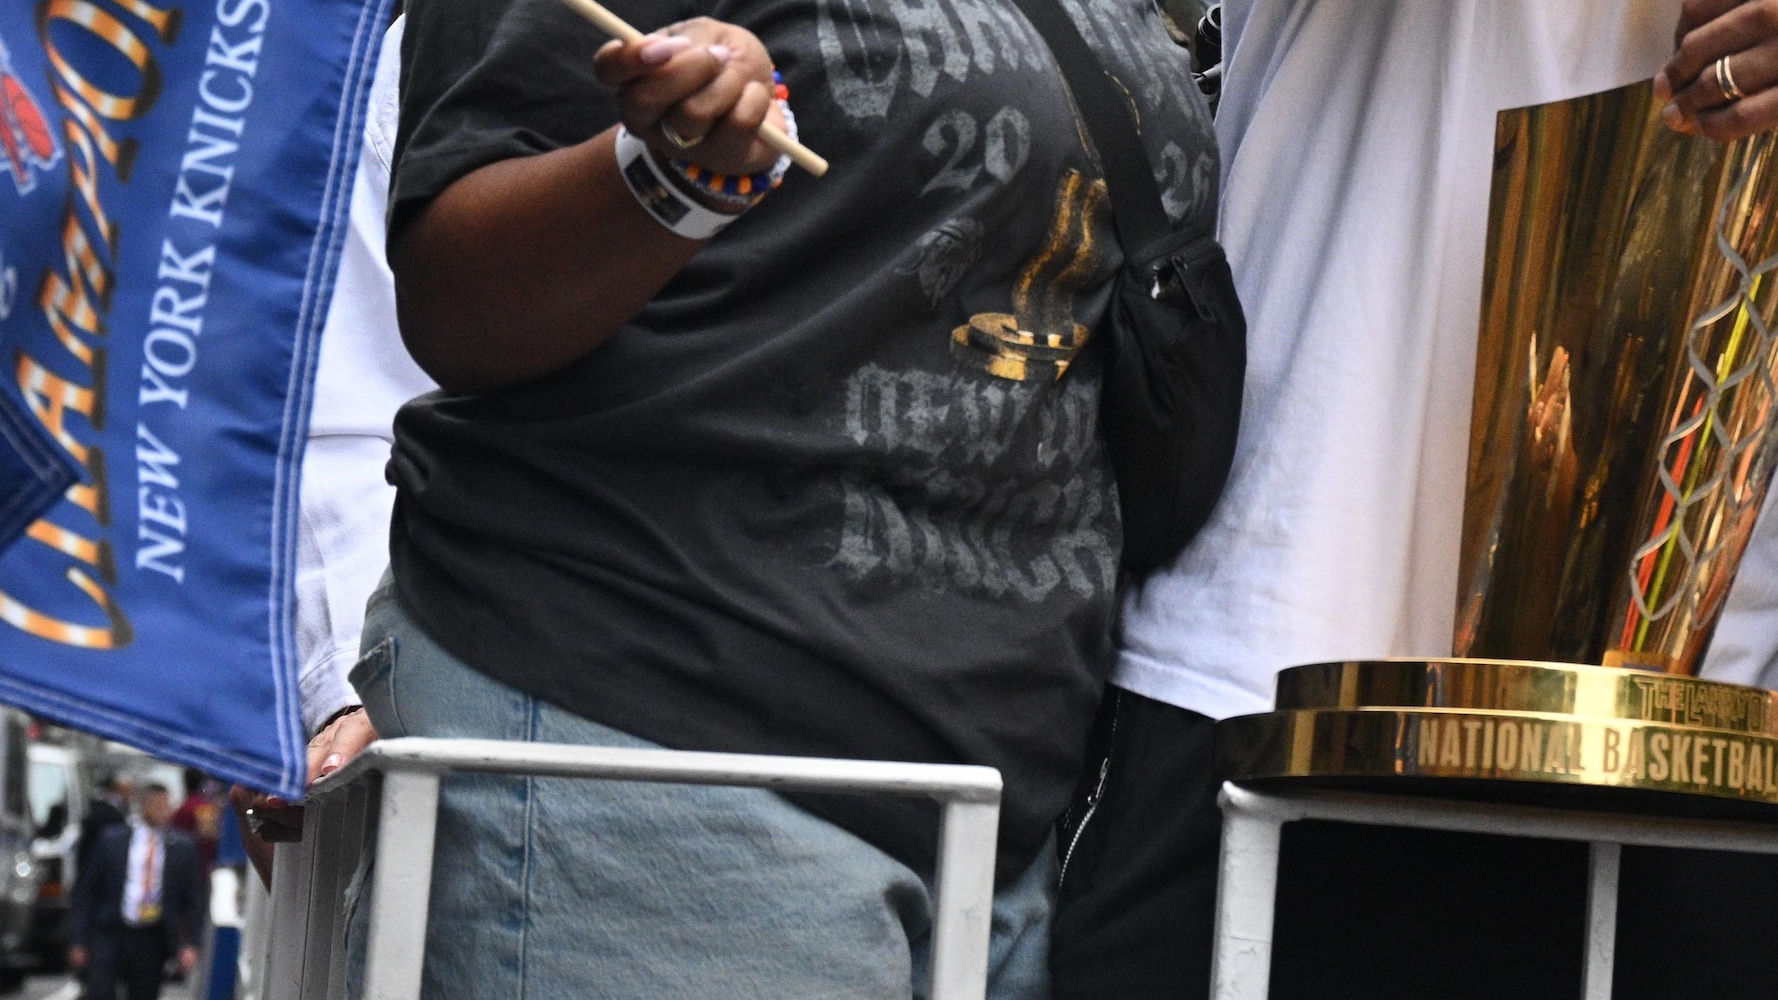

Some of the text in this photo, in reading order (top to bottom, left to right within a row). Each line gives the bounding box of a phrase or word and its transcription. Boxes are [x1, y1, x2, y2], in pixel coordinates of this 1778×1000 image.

[920, 105, 1031, 197] 20
[138, 236, 218, 411] YORK
[136, 424, 186, 582] NEW
[1418, 718, 1585, 774] NATIONAL
